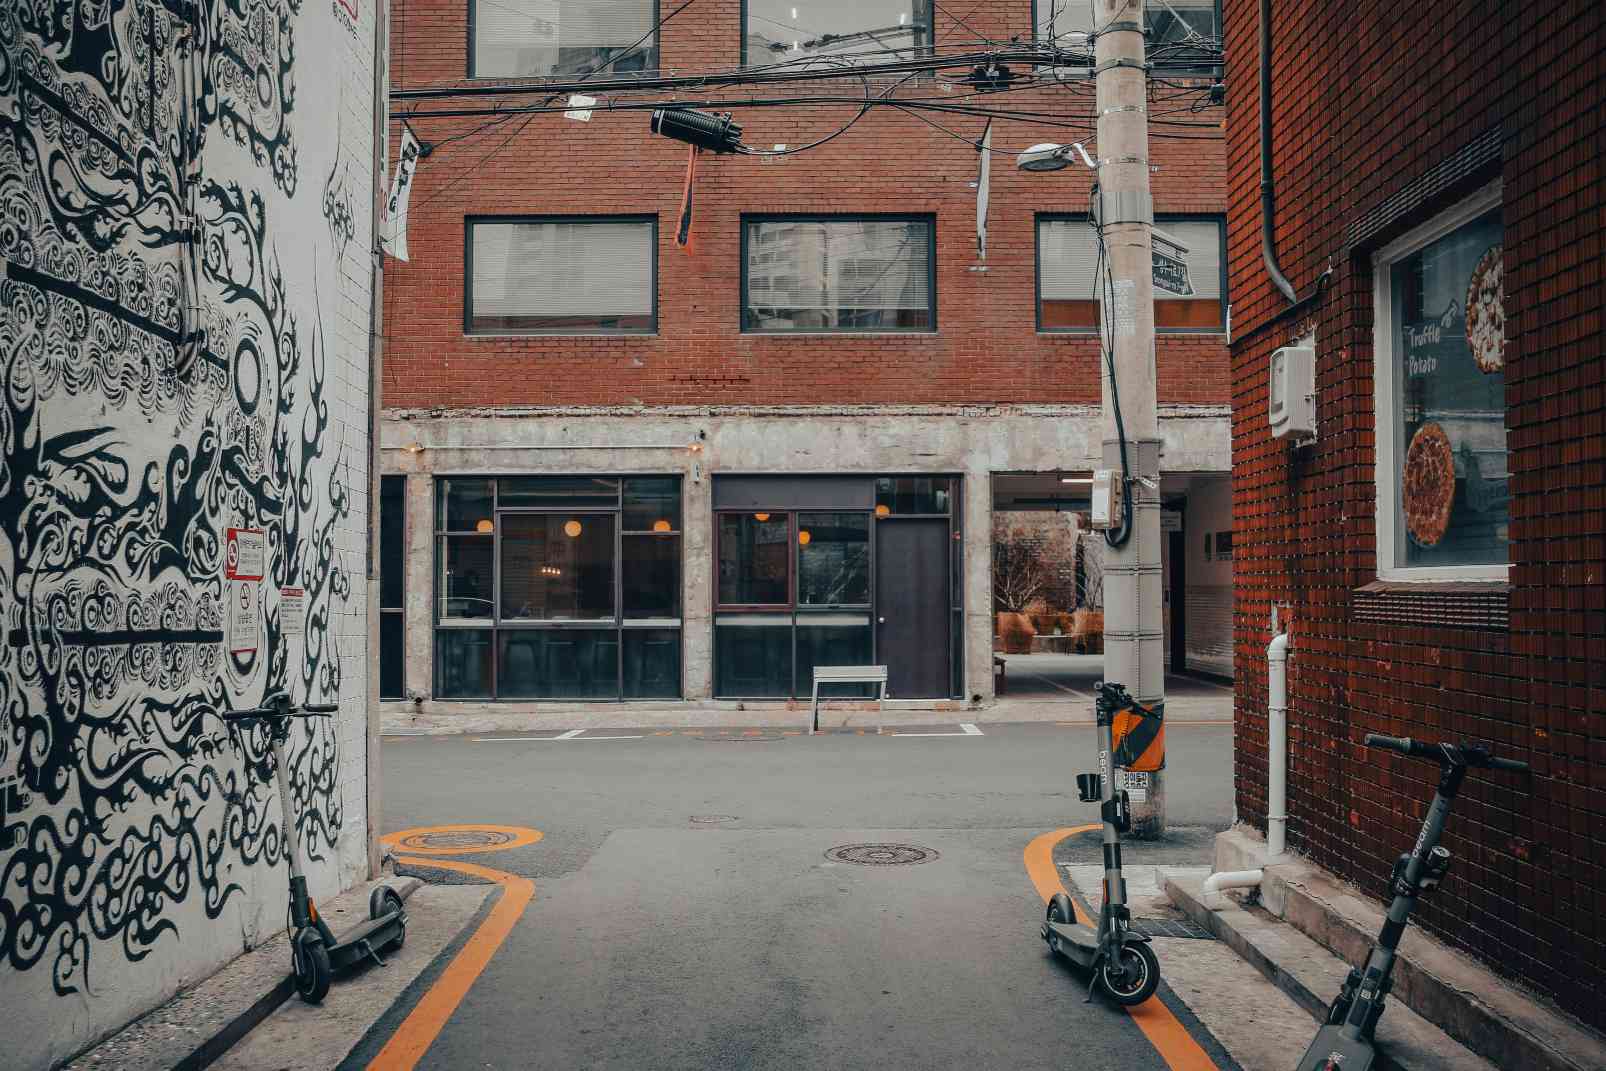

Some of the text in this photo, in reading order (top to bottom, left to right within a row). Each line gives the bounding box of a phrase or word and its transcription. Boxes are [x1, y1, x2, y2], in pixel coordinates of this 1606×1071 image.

[1408, 323, 1440, 347] Truffle
[1408, 355, 1437, 377] Potato
[1099, 751, 1107, 785] beam
